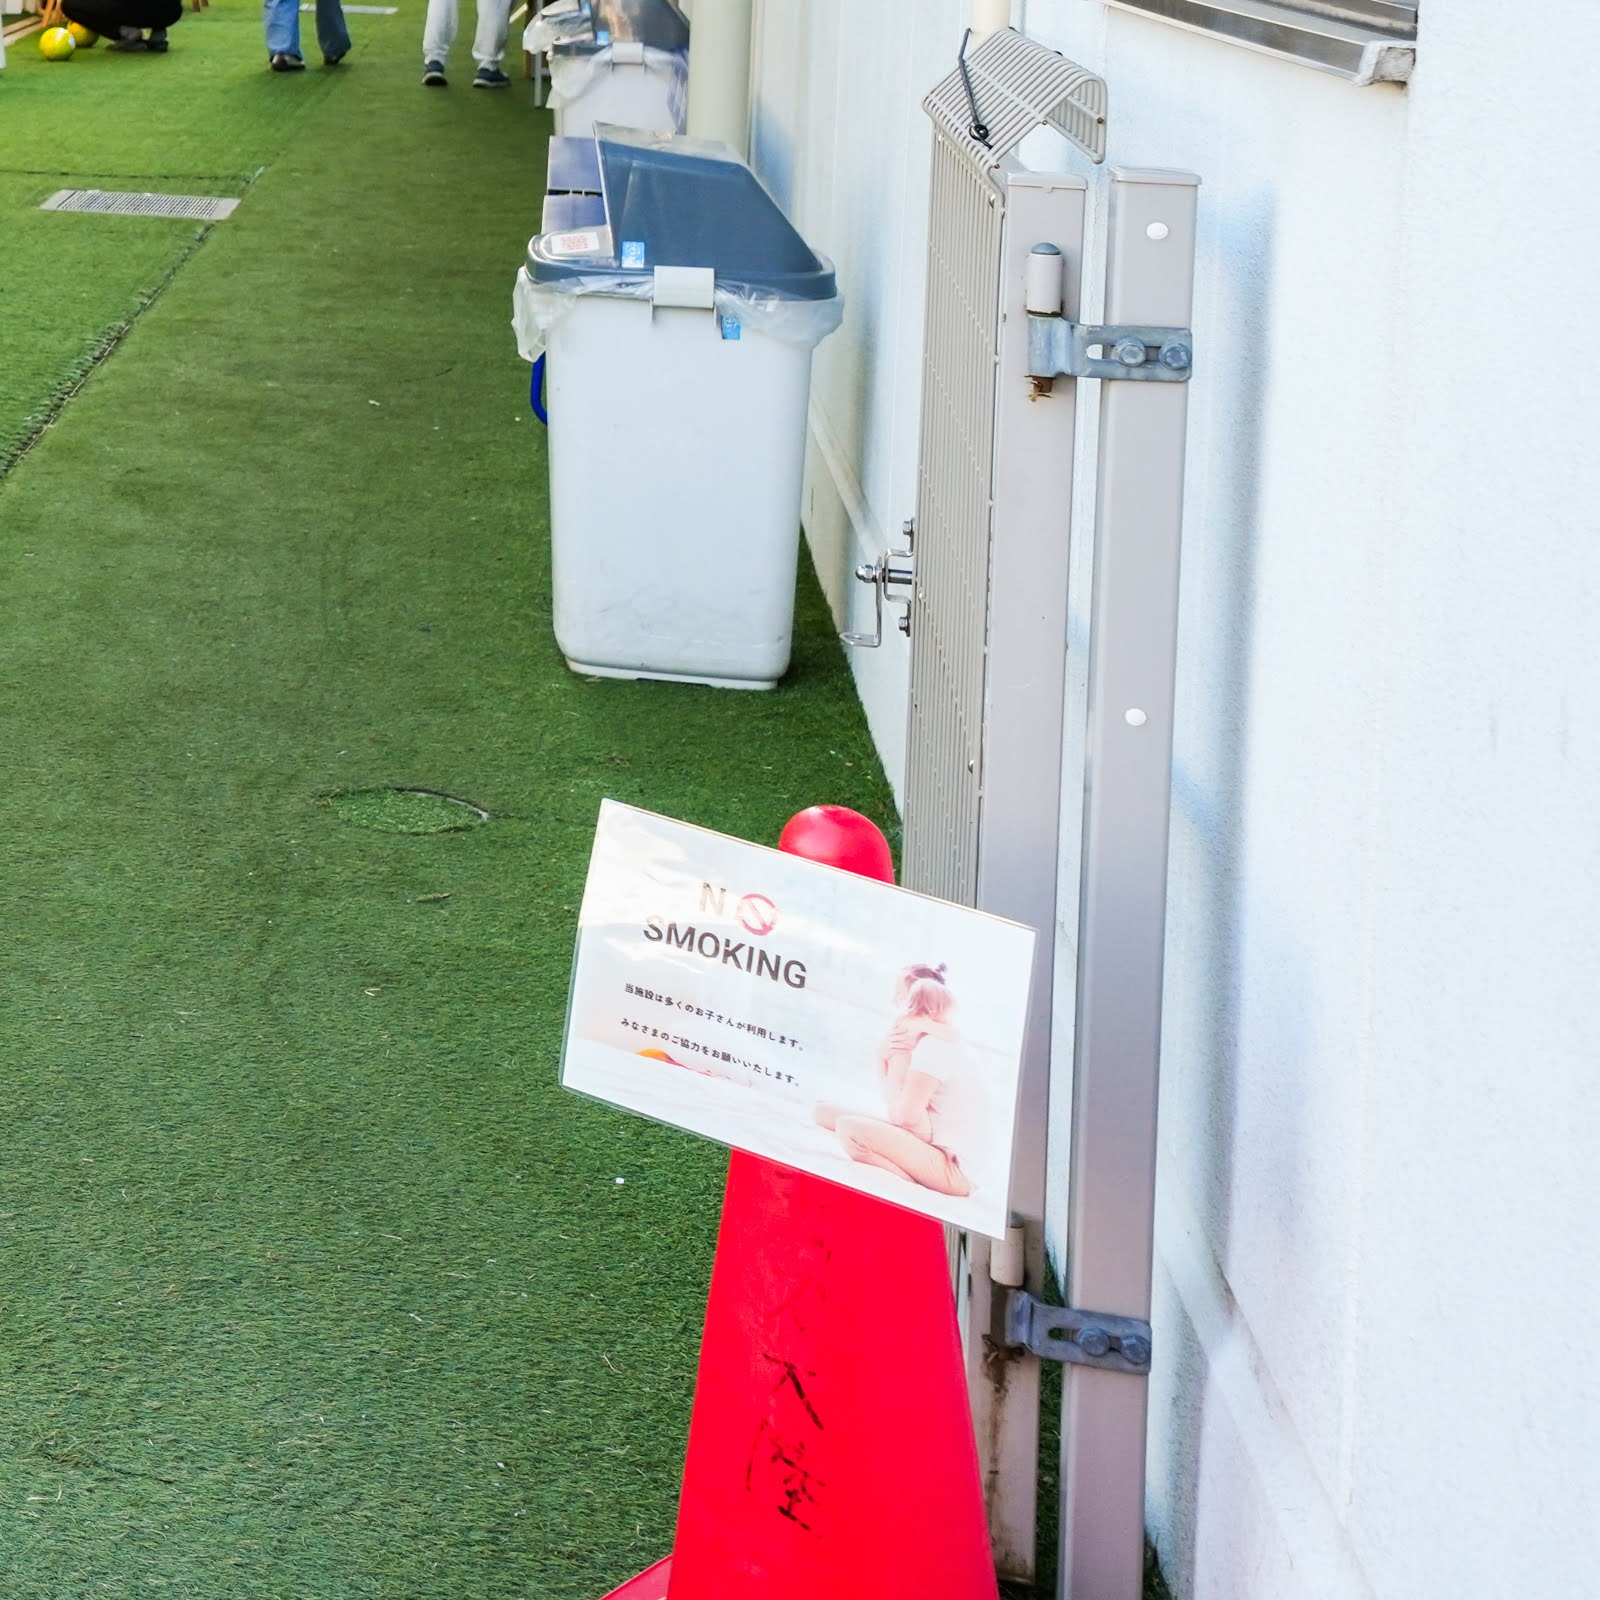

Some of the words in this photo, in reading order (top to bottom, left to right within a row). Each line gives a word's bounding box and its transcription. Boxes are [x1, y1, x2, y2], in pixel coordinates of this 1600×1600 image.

[642, 914, 808, 990] SMOKING
[620, 1016, 801, 1088] みなさまのご協力をお願いいたします。
[623, 981, 805, 1053] 当施設は多くのお子さんが利用します。
